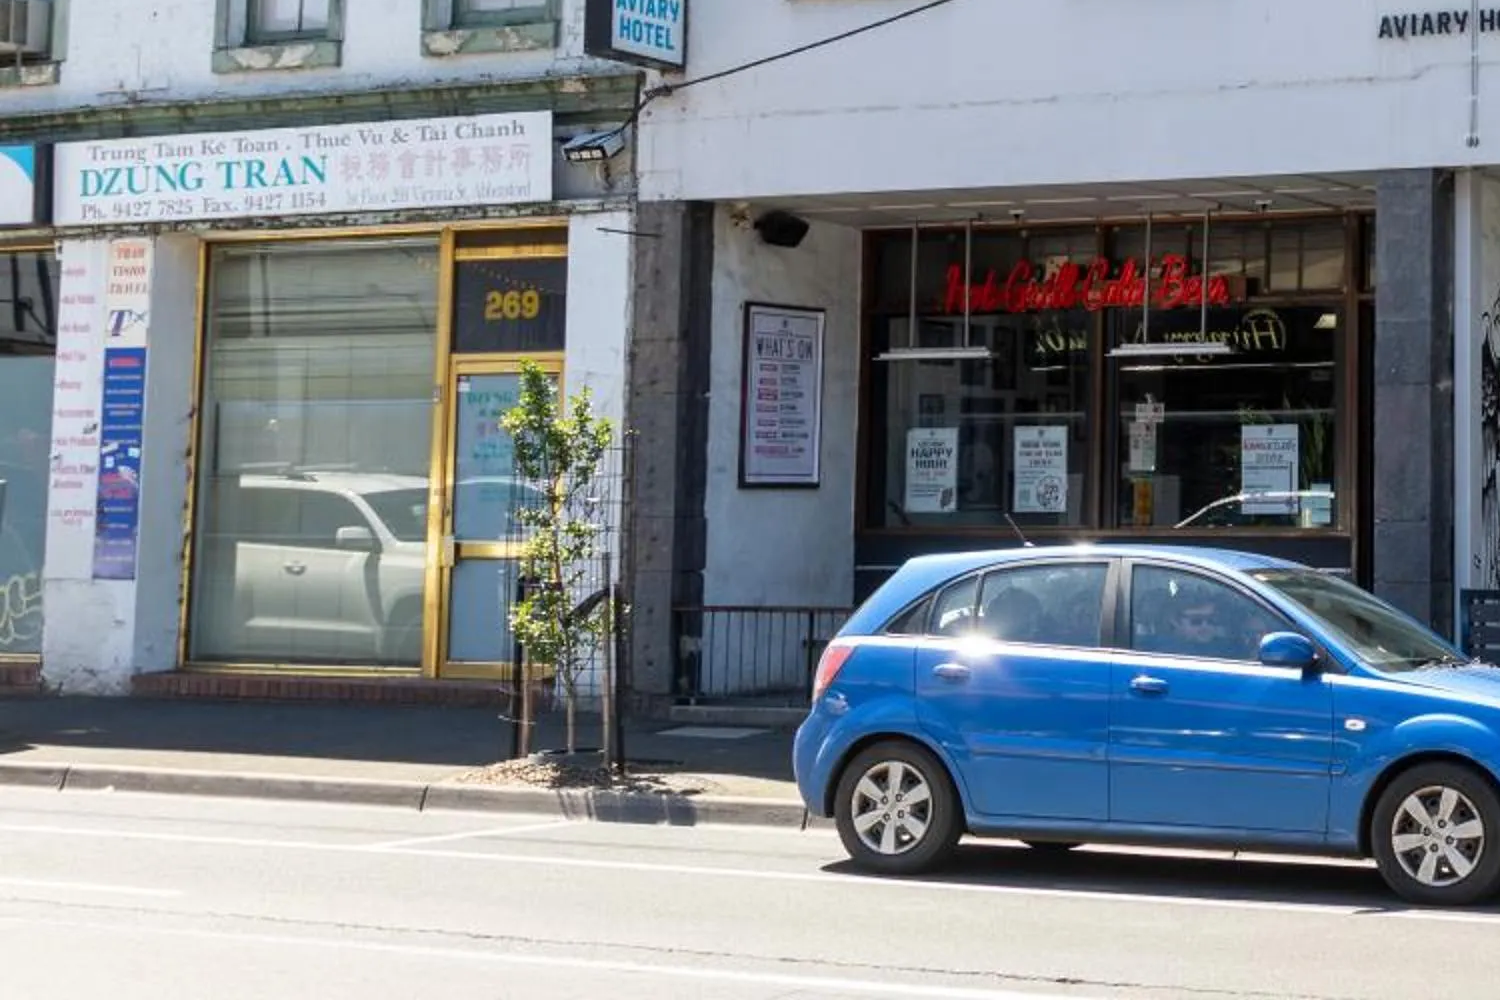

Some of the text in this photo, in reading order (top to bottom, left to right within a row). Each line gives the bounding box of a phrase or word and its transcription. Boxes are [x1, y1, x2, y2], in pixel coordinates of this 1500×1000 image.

[619, 15, 675, 50] HOTEL
[1378, 9, 1469, 39] AVIARY
[88, 145, 147, 163] Trung
[390, 127, 410, 143] &
[454, 119, 526, 139] Chanh
[79, 154, 328, 198] DZUNG TRAN
[483, 289, 539, 321] 269
[756, 336, 795, 359] WHAT'S
[911, 447, 953, 459] HAPPY
